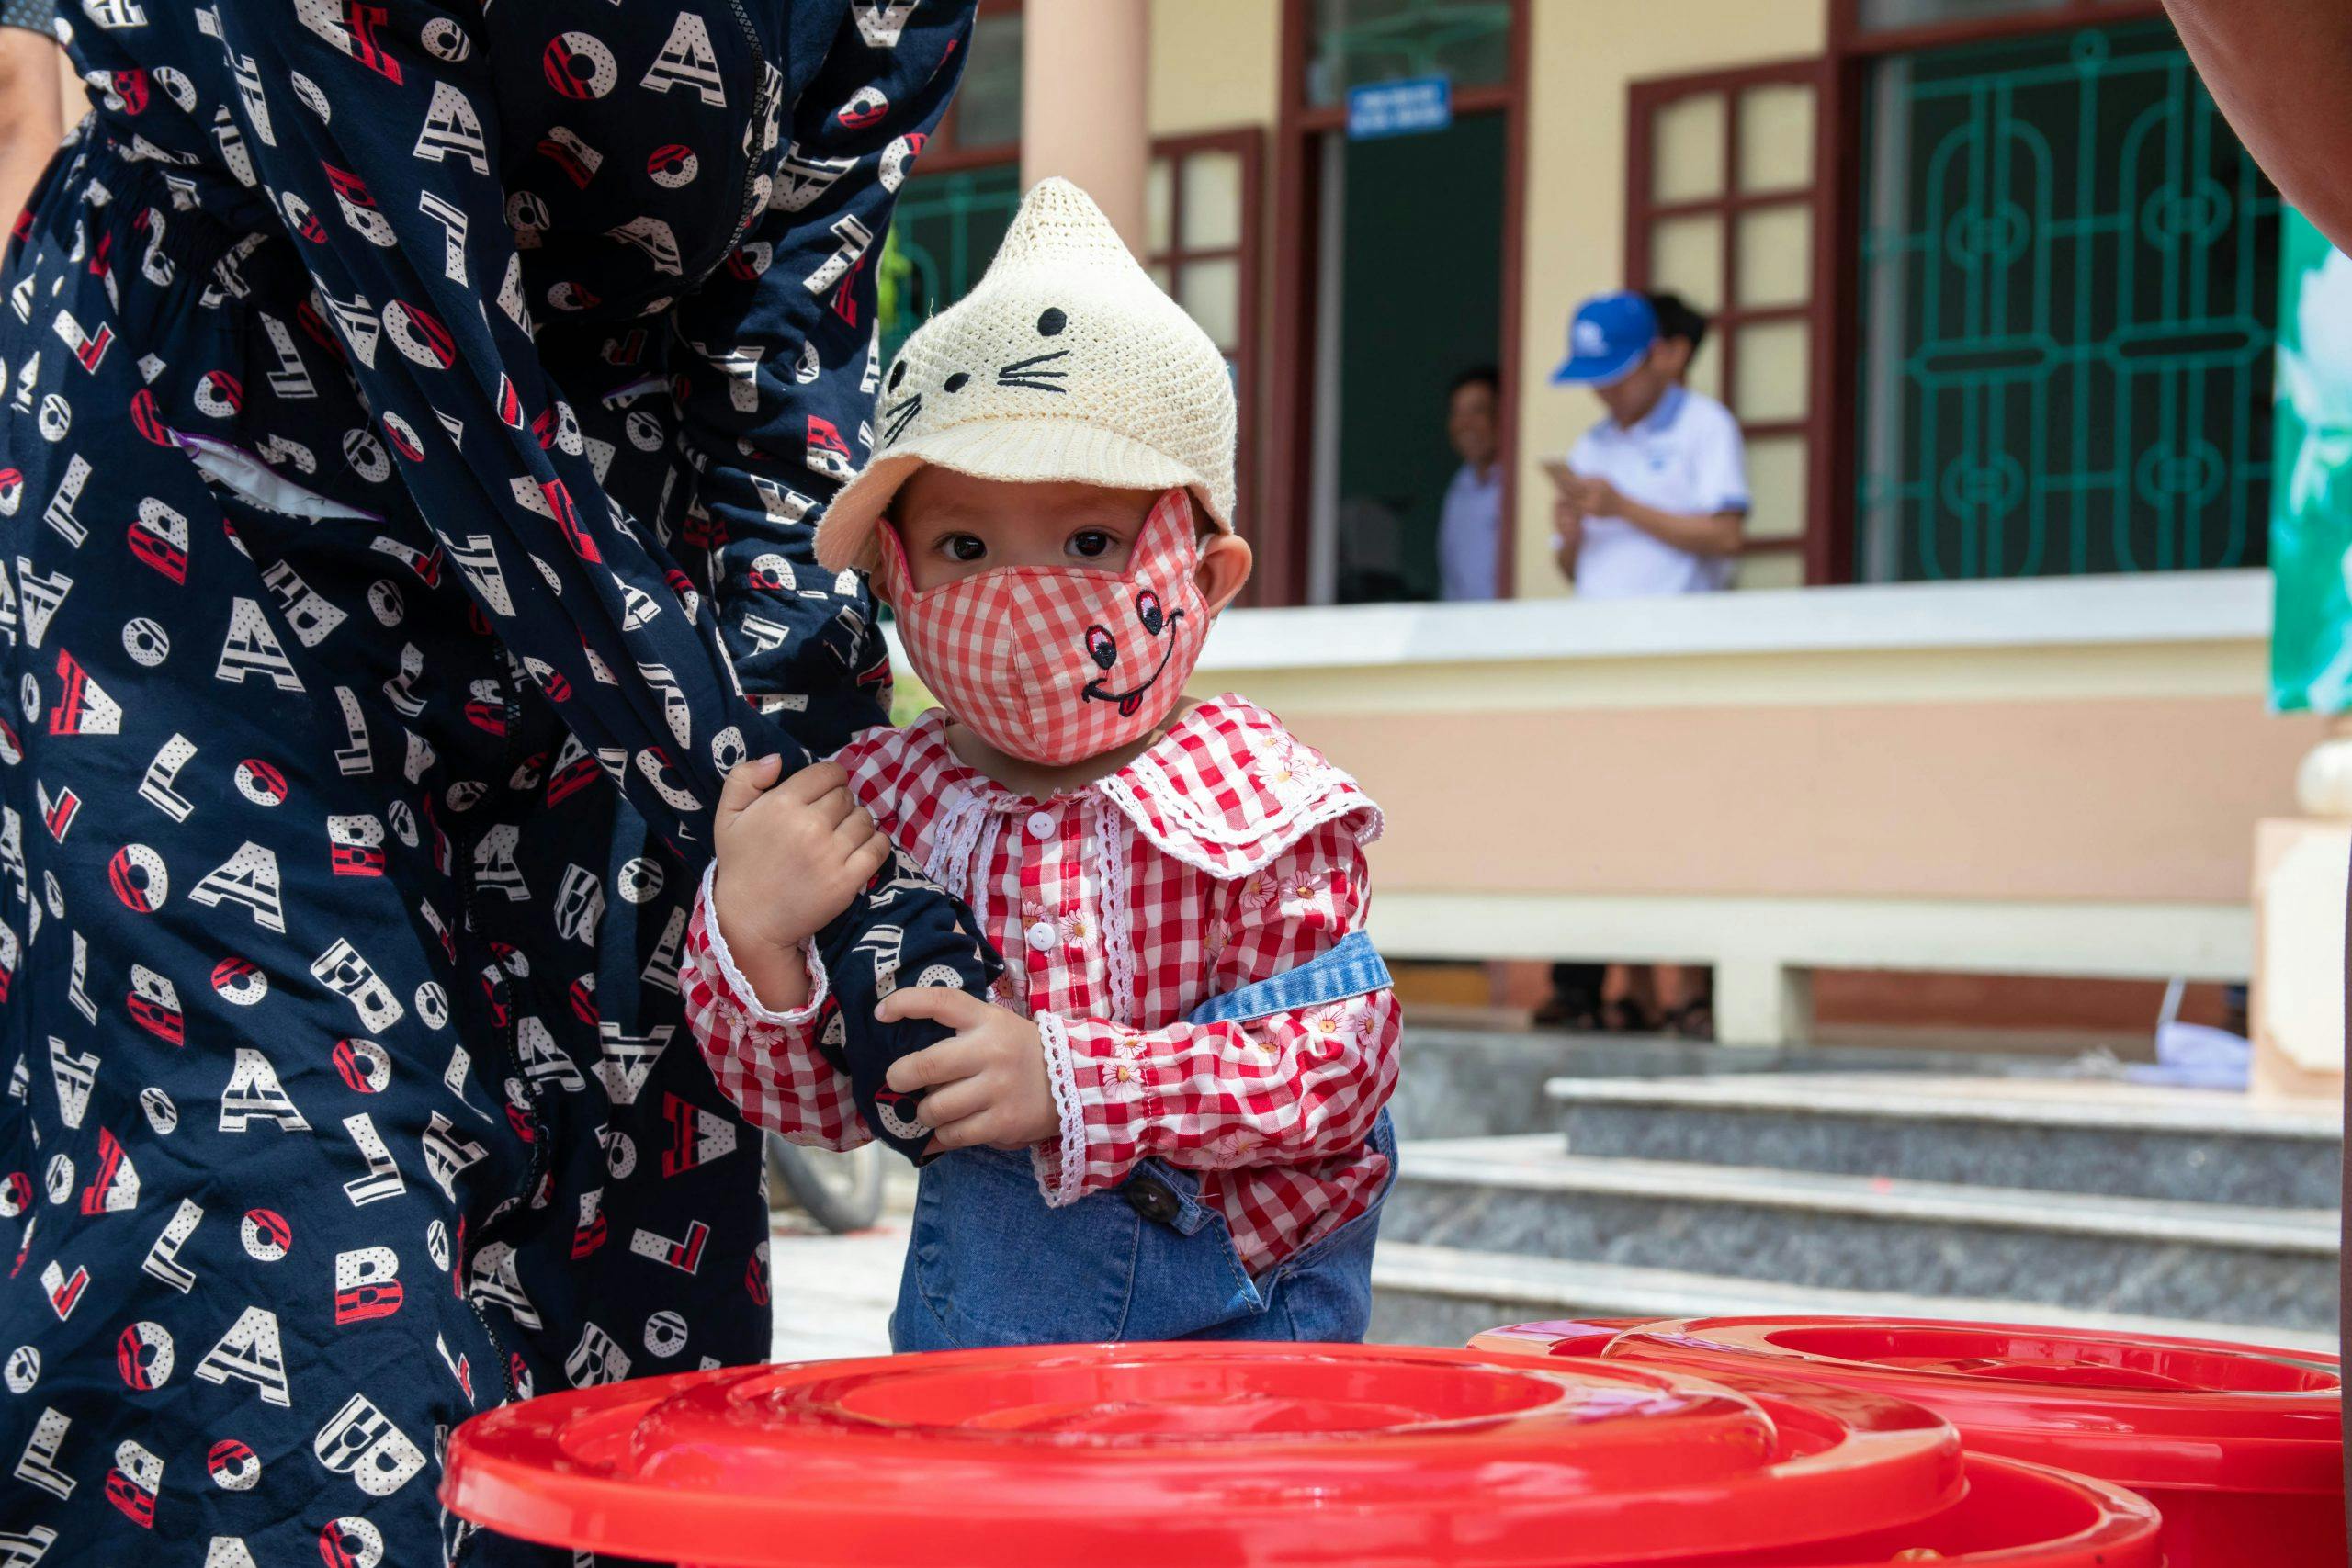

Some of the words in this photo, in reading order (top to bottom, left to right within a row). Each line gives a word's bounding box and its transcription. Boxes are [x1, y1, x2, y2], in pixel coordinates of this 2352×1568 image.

[421, 17, 470, 62] O
[543, 31, 617, 99] O
[639, 11, 727, 107] A
[153, 66, 198, 114] O
[838, 85, 889, 129] O
[413, 80, 490, 175] A
[647, 143, 699, 188] O
[768, 140, 861, 212] A
[282, 191, 329, 243] O
[419, 189, 469, 288] L
[506, 190, 550, 230] O
[727, 241, 773, 279] O
[802, 213, 873, 295] L
[52, 309, 116, 376] L
[260, 309, 320, 398] L
[382, 299, 456, 369] O
[39, 393, 72, 442] O
[193, 370, 243, 418] O
[342, 428, 390, 482] O
[382, 410, 425, 462] O
[626, 412, 664, 451] O
[43, 453, 93, 548] L
[127, 496, 188, 586] B
[17, 555, 74, 649] A
[368, 579, 404, 627] O
[122, 617, 170, 666] O
[214, 597, 307, 693] A
[21, 672, 40, 723] O
[49, 647, 122, 735] A
[523, 656, 572, 702] O
[334, 686, 374, 775] L
[138, 732, 198, 823] L
[234, 758, 288, 807] O
[327, 814, 386, 877] B
[388, 799, 419, 847] O
[108, 843, 169, 913] O
[187, 840, 286, 933] A
[618, 857, 663, 903] O
[127, 964, 184, 1046] B
[211, 957, 268, 1006] O
[311, 938, 404, 1034] B
[415, 981, 448, 1030] O
[48, 1035, 101, 1129] A
[219, 1048, 312, 1132] A
[332, 1038, 391, 1093] O
[140, 1087, 177, 1135] O
[662, 1091, 737, 1179] A
[46, 1154, 74, 1204] O
[81, 1125, 141, 1215] A
[343, 1112, 406, 1207] L
[606, 1132, 637, 1179] O
[141, 1197, 204, 1293] L
[241, 1208, 292, 1261] O
[629, 1219, 710, 1275] L
[40, 1259, 90, 1321] L
[335, 1246, 403, 1325] B
[469, 1241, 543, 1331] A
[117, 1321, 175, 1391] O
[193, 1306, 291, 1407] A
[643, 1311, 688, 1359] O
[4, 1345, 40, 1394] O
[14, 1406, 77, 1501] L
[208, 1439, 261, 1491] O
[314, 1393, 427, 1496] B
[105, 1439, 164, 1529] B
[319, 1517, 384, 1568] O
